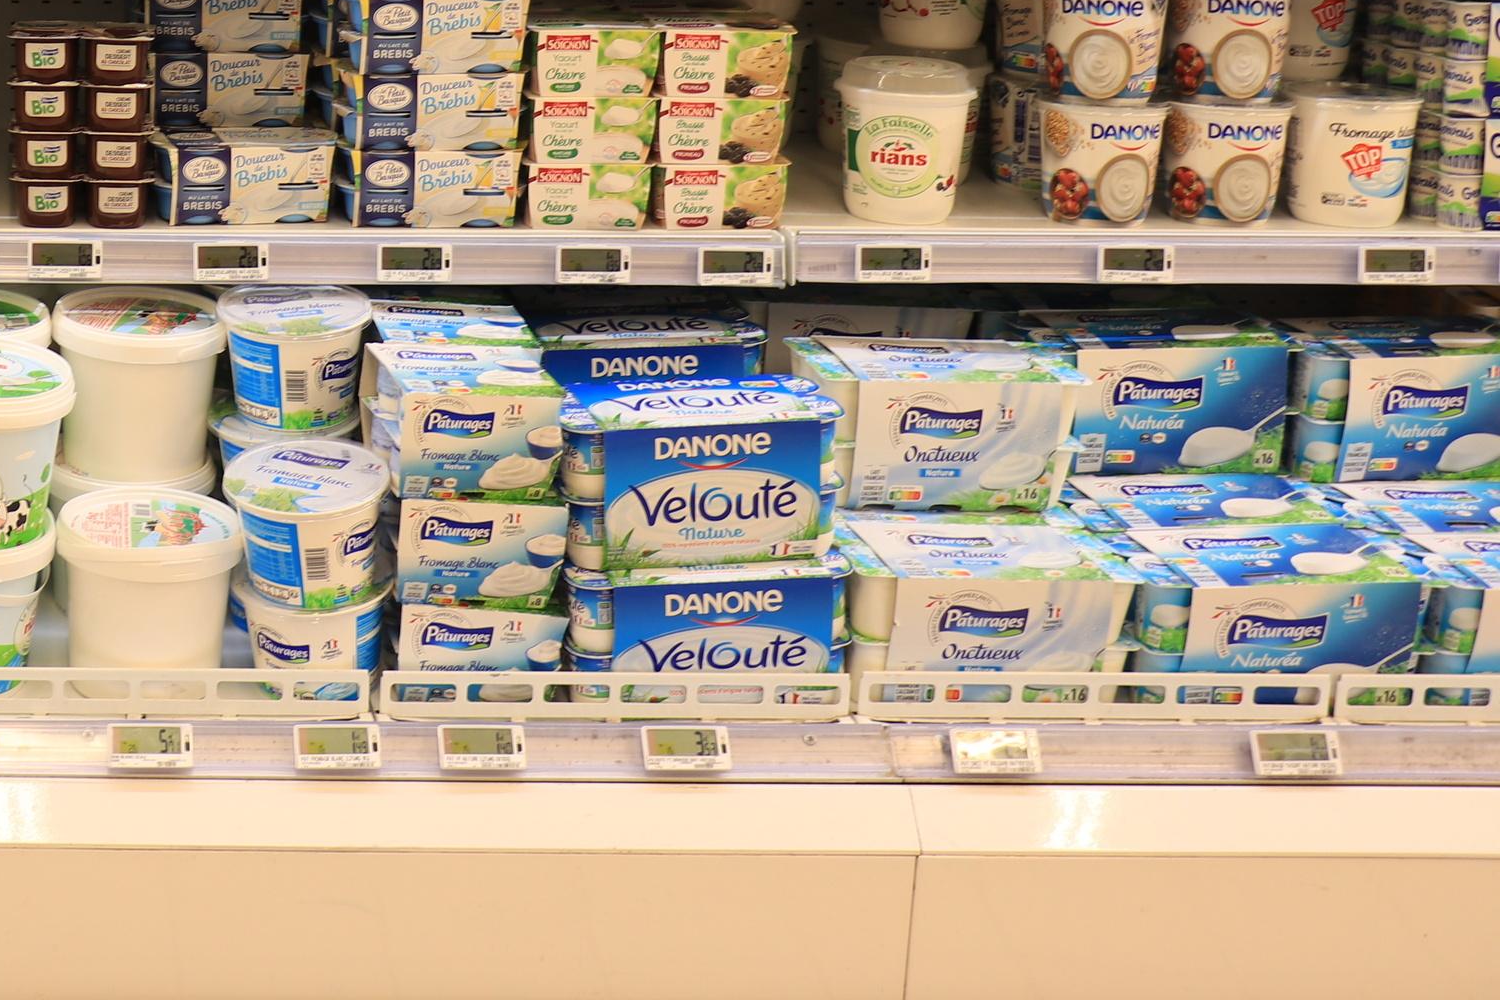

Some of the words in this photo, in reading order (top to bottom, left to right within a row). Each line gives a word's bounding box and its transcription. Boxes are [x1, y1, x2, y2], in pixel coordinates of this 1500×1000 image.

[425, 0, 479, 18] Douceur
[1318, 3, 1344, 23] TOP
[426, 12, 482, 34] Brebis
[548, 38, 591, 50] SOIGNON
[676, 38, 721, 49] SOIGNON
[373, 48, 414, 60] BREBIS
[545, 66, 586, 82] Chèvre
[673, 66, 714, 82] Chèvre
[883, 117, 934, 138] Faisselle
[1329, 122, 1394, 142] Fromage
[234, 151, 285, 169] Douceur
[871, 148, 927, 166] rians
[1346, 150, 1381, 168] TOP
[235, 163, 289, 187] Brebis
[183, 200, 222, 211] BREBIS
[1119, 413, 1185, 430] Naturéa
[1386, 421, 1448, 439] Naturéa
[421, 448, 466, 464] Fromage
[468, 451, 500, 462] Blanc
[904, 444, 980, 465] Onctueux
[1253, 450, 1274, 466] x16
[630, 478, 798, 528] Velouté
[1016, 487, 1038, 501] x16
[678, 527, 745, 541] Nature
[419, 555, 466, 570] Fromage
[468, 558, 500, 569] Blanc
[638, 634, 808, 671] Velouté
[941, 642, 1024, 662] Onctueux
[1231, 650, 1303, 668] Naturéa
